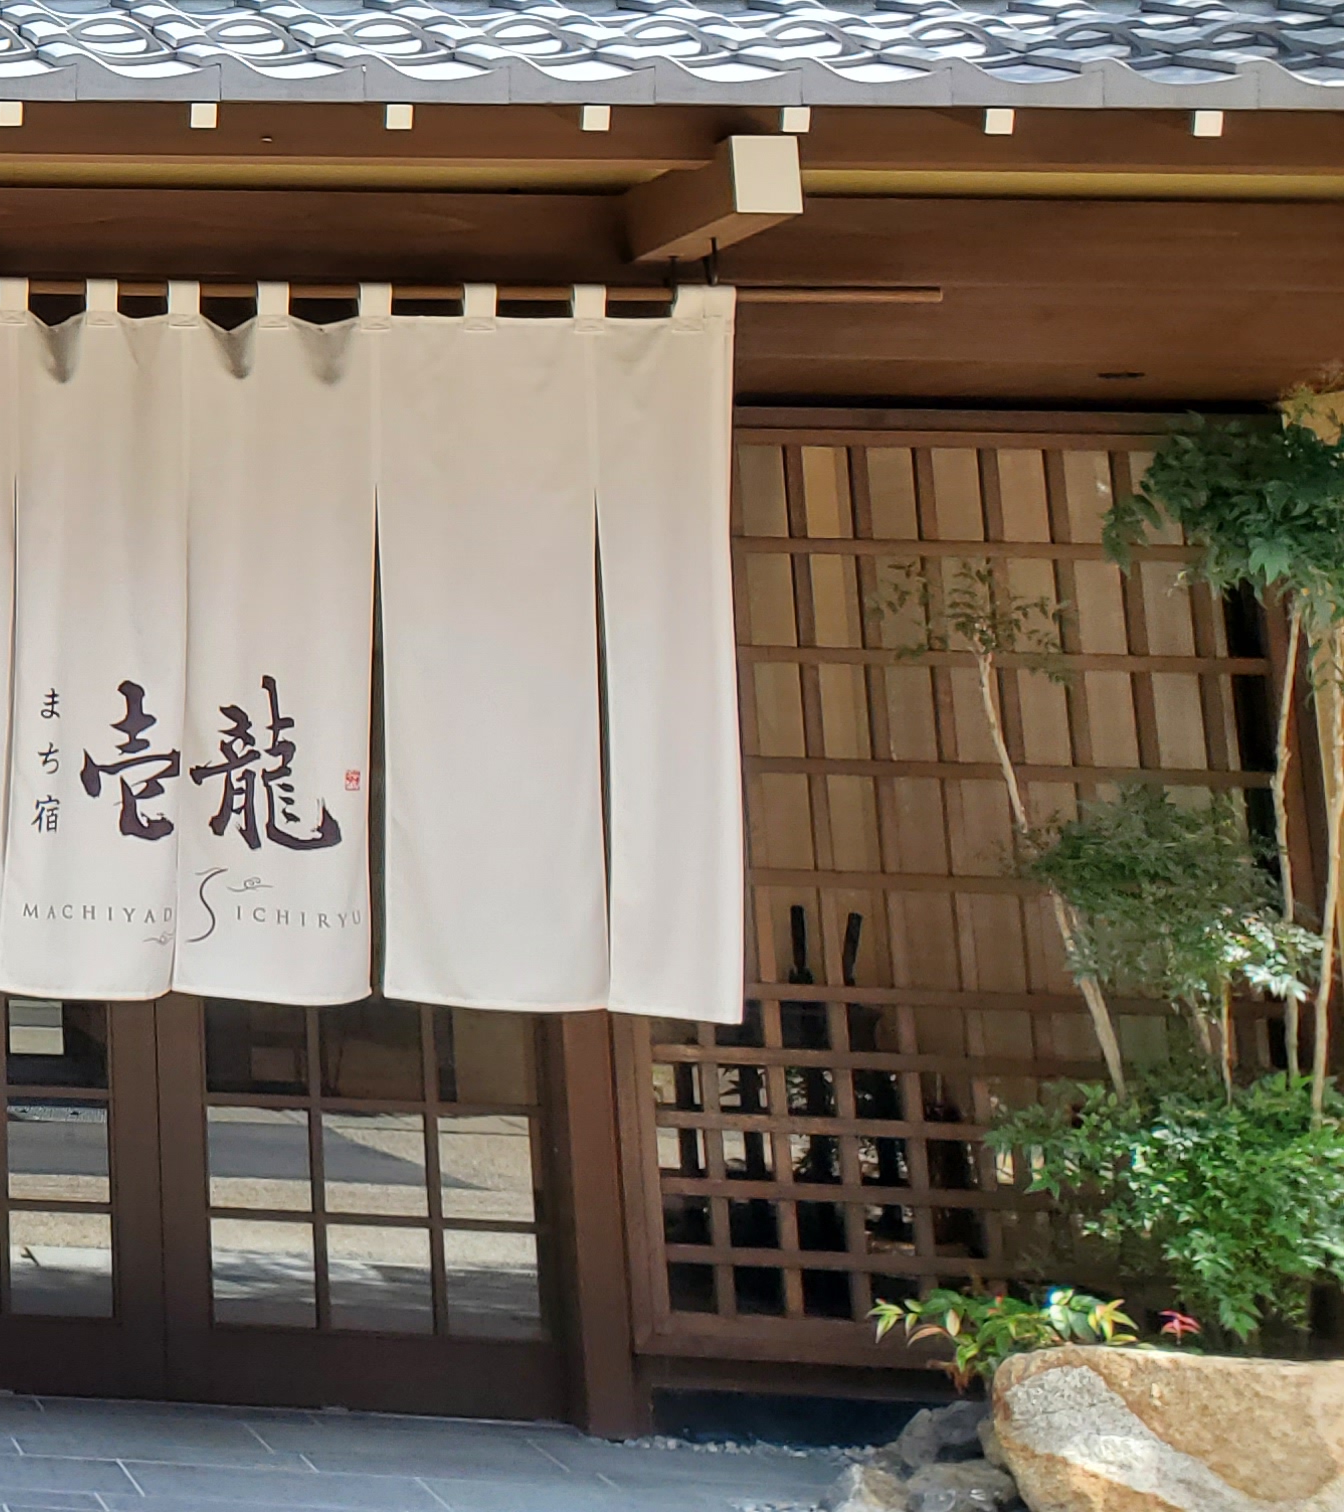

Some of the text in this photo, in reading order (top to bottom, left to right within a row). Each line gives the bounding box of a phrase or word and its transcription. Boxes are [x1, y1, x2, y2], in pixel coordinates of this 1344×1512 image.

[30, 687, 61, 834] まち宿
[22, 903, 361, 929] MACHIYAD ICHIRYU
